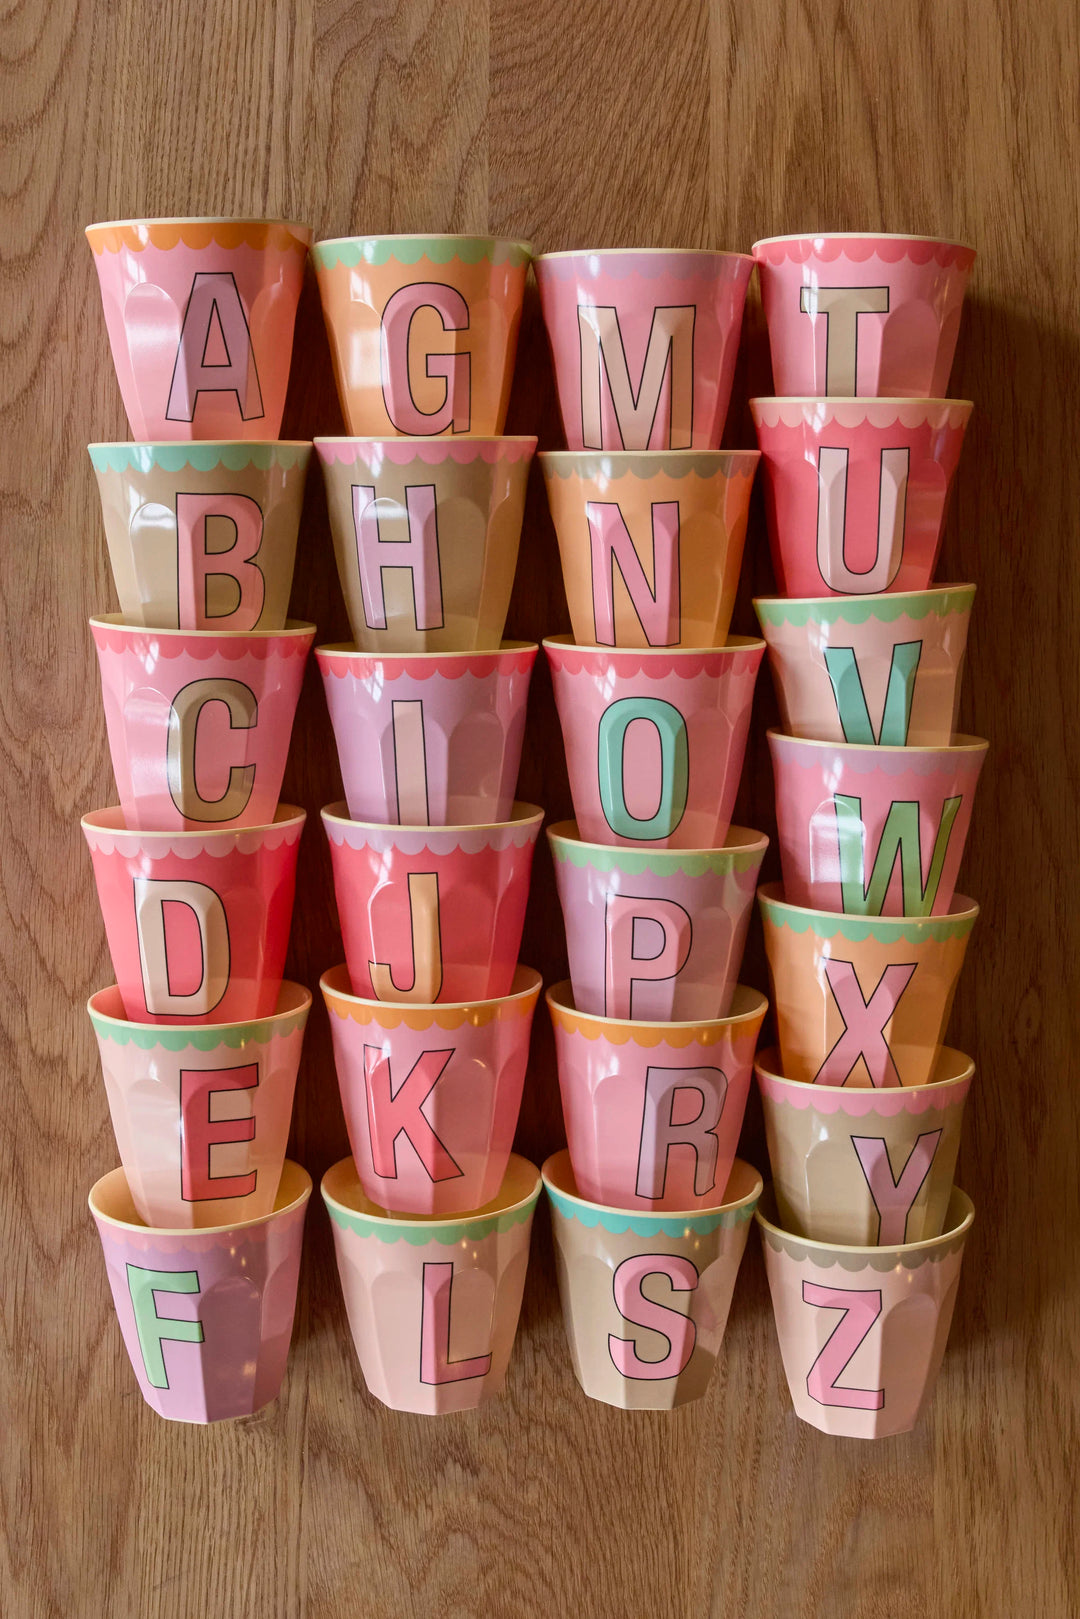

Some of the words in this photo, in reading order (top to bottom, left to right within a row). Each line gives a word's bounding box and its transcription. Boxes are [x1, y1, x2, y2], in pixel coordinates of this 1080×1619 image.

[166, 273, 264, 422] A
[382, 282, 472, 435] G
[577, 305, 695, 449] M
[800, 286, 889, 396] T
[176, 493, 265, 630] B
[351, 484, 443, 630] H
[586, 502, 681, 647] N
[817, 447, 910, 593] U
[166, 677, 258, 823] C
[824, 640, 923, 745] V
[392, 699, 430, 825] I
[598, 697, 689, 840] O
[833, 794, 961, 917] W
[133, 879, 229, 1016] D
[368, 872, 443, 1004] J
[603, 895, 691, 1020] P
[813, 957, 919, 1088] X
[181, 1063, 258, 1202] E
[363, 1045, 464, 1182] K
[635, 1066, 727, 1199] R
[850, 1128, 944, 1247] Y
[126, 1263, 204, 1390] F
[419, 1262, 493, 1385] L
[607, 1252, 697, 1381] S
[801, 1280, 887, 1410] Z
